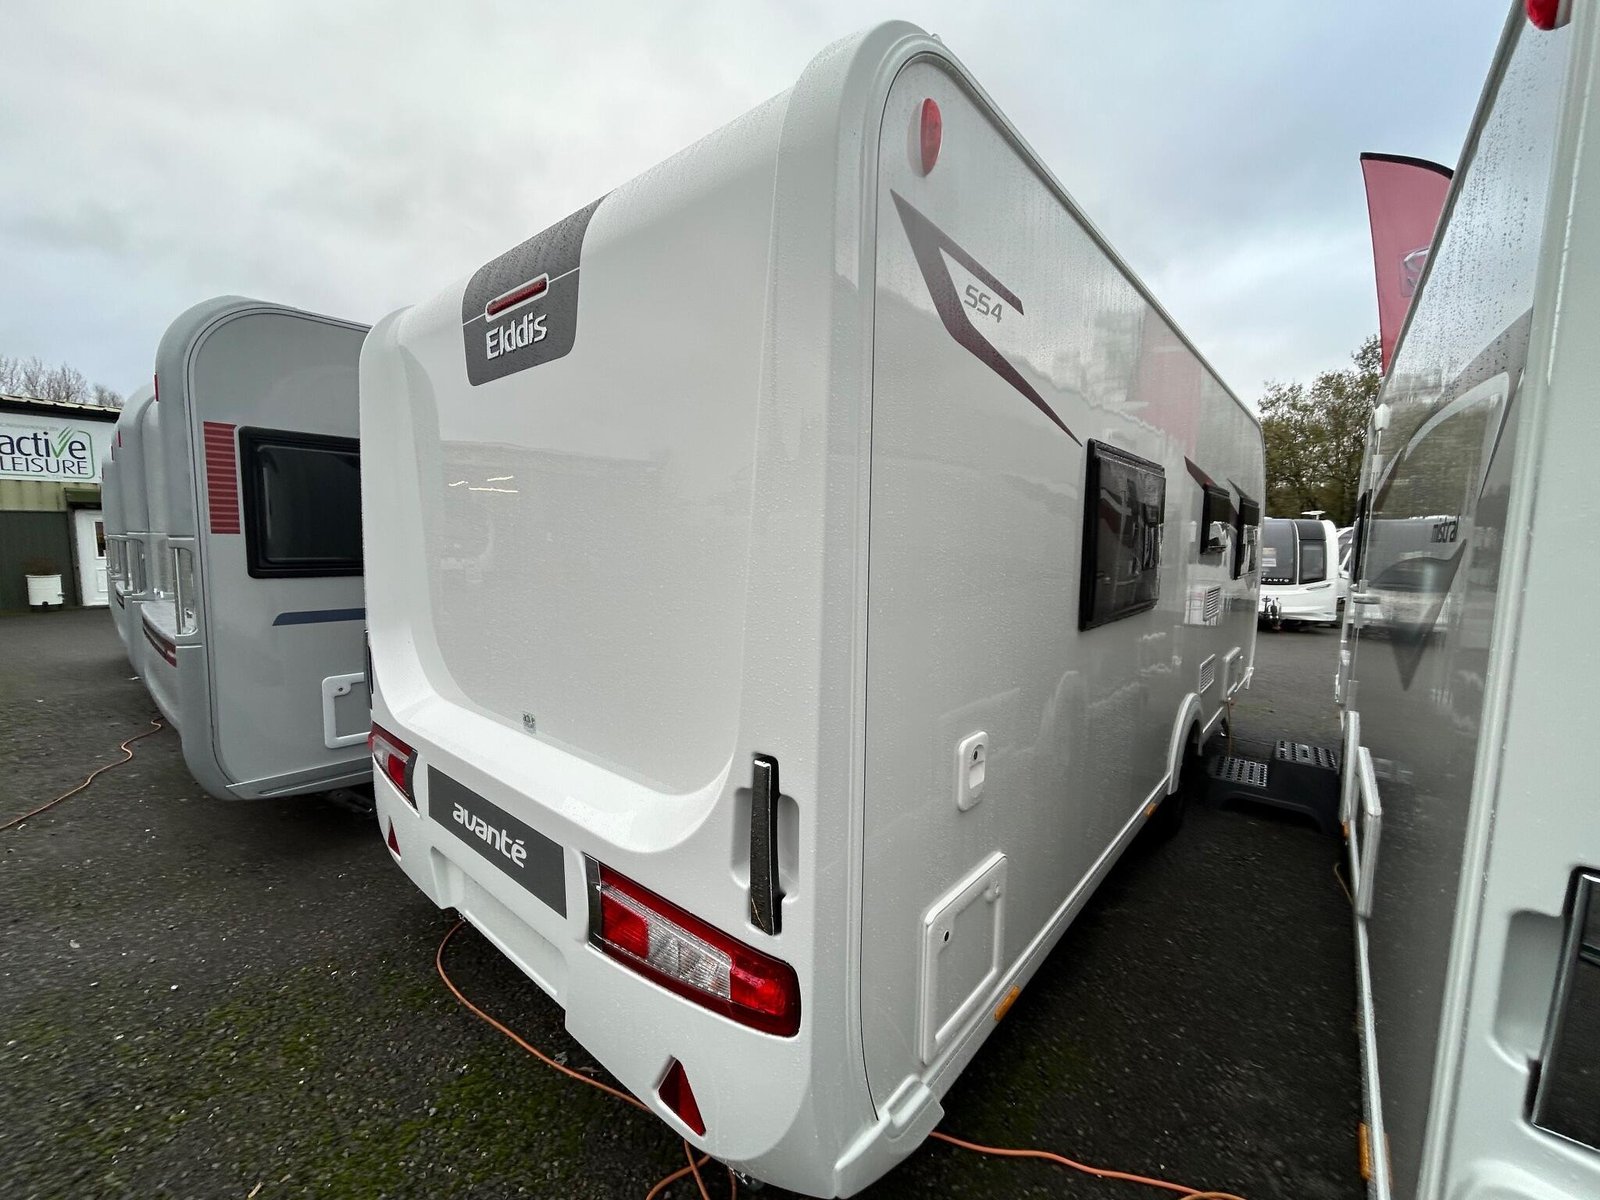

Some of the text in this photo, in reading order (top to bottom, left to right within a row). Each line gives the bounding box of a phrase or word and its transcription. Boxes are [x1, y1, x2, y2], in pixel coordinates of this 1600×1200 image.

[486, 312, 547, 360] Elddis
[0, 427, 86, 460] active
[0, 456, 88, 475] LEISURE
[452, 802, 527, 868] avanté
